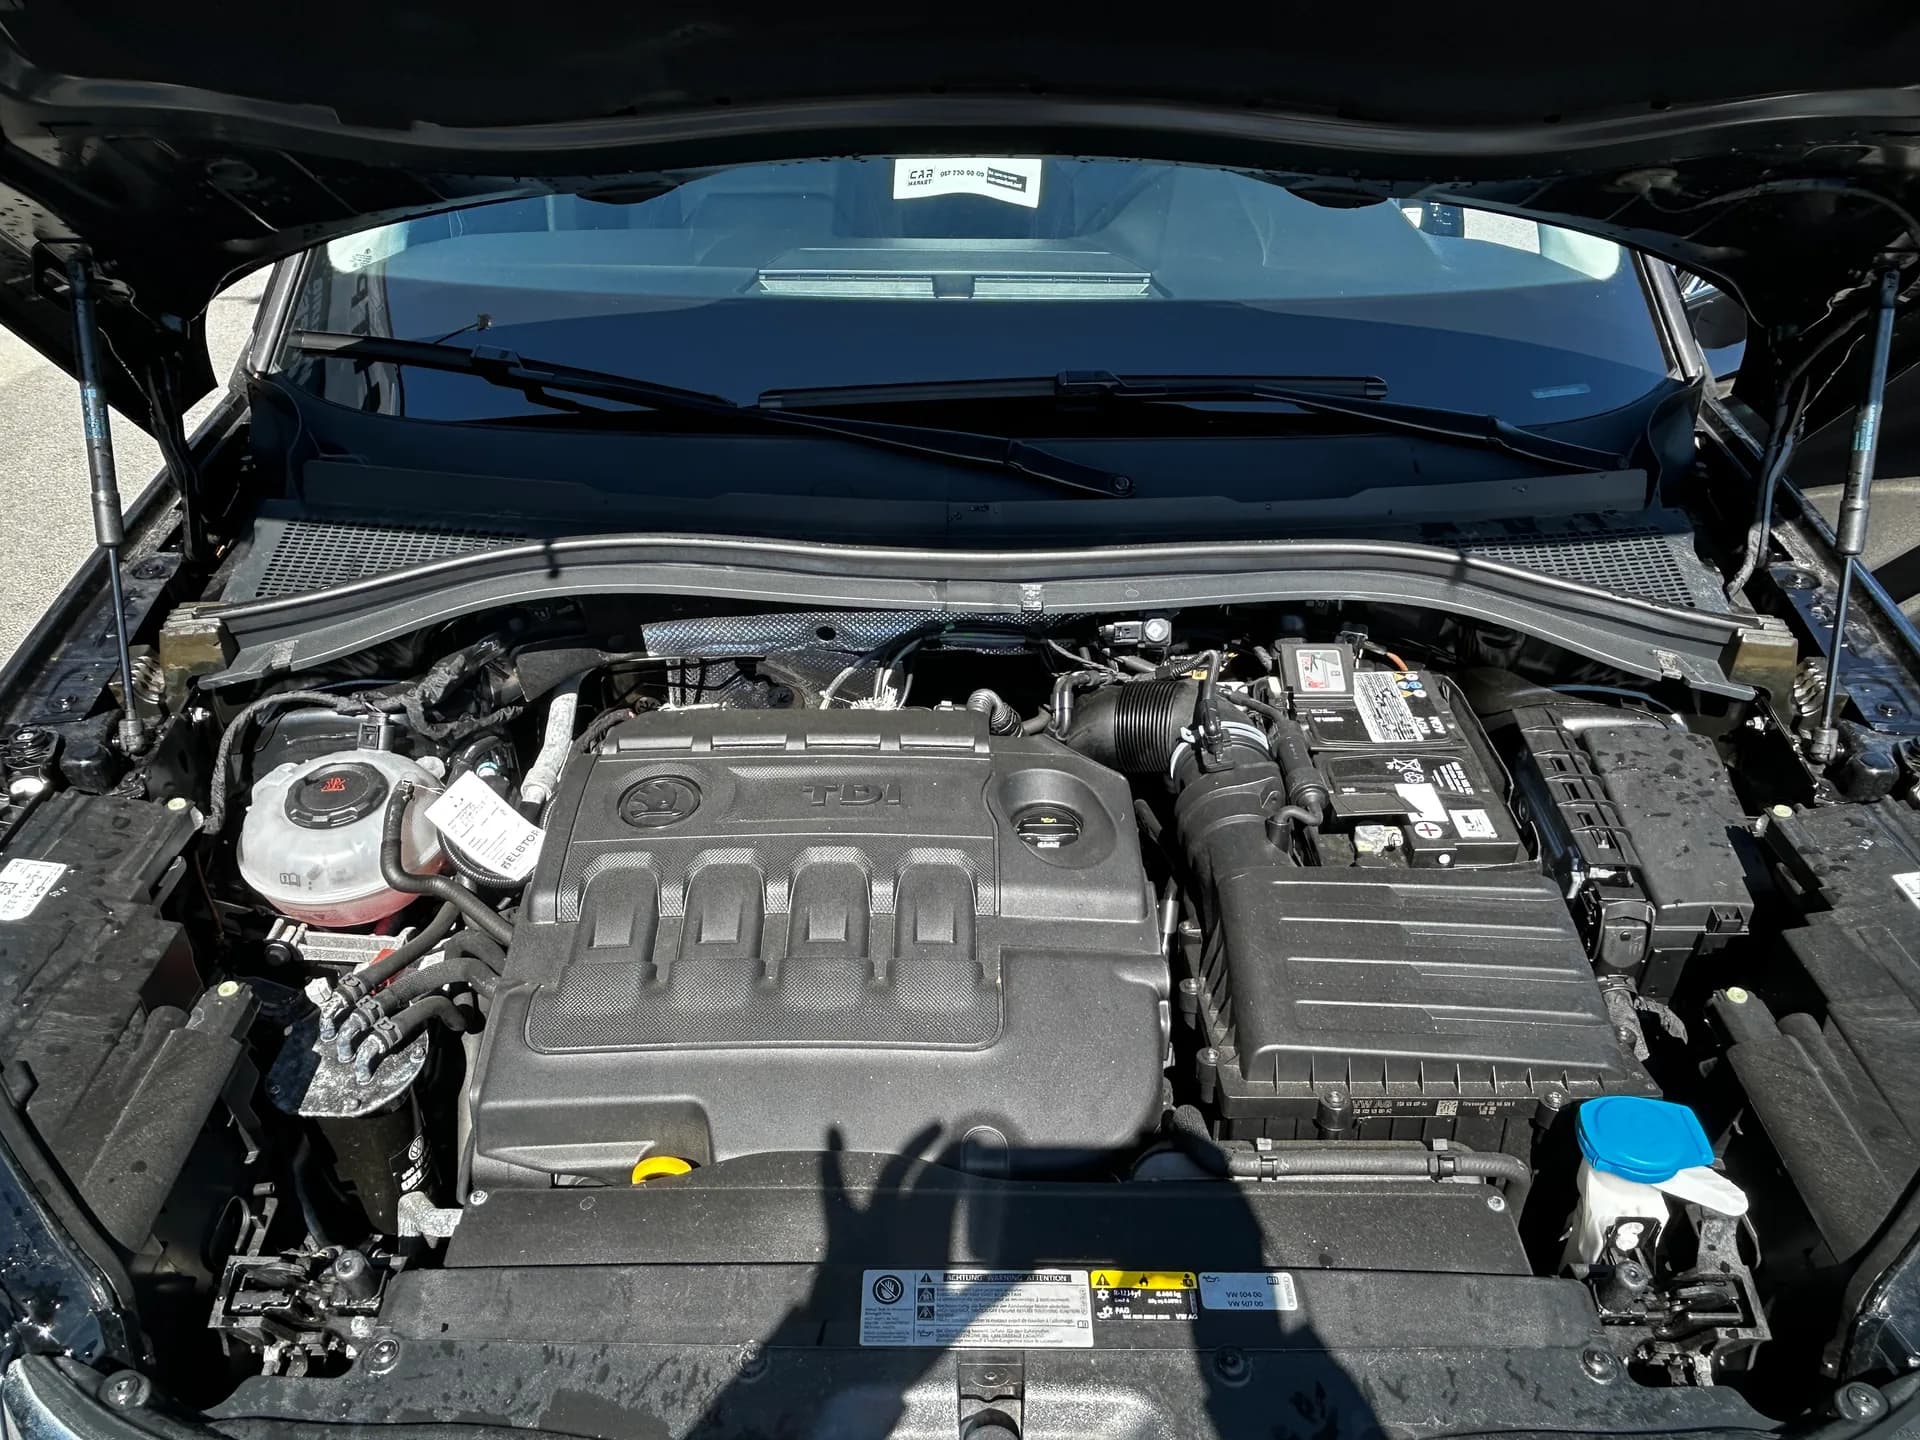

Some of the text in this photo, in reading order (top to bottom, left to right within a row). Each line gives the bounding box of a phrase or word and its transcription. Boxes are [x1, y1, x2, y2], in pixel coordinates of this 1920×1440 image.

[909, 169, 934, 179] CAR
[802, 784, 901, 807] TDI
[1352, 1100, 1373, 1108] VW
